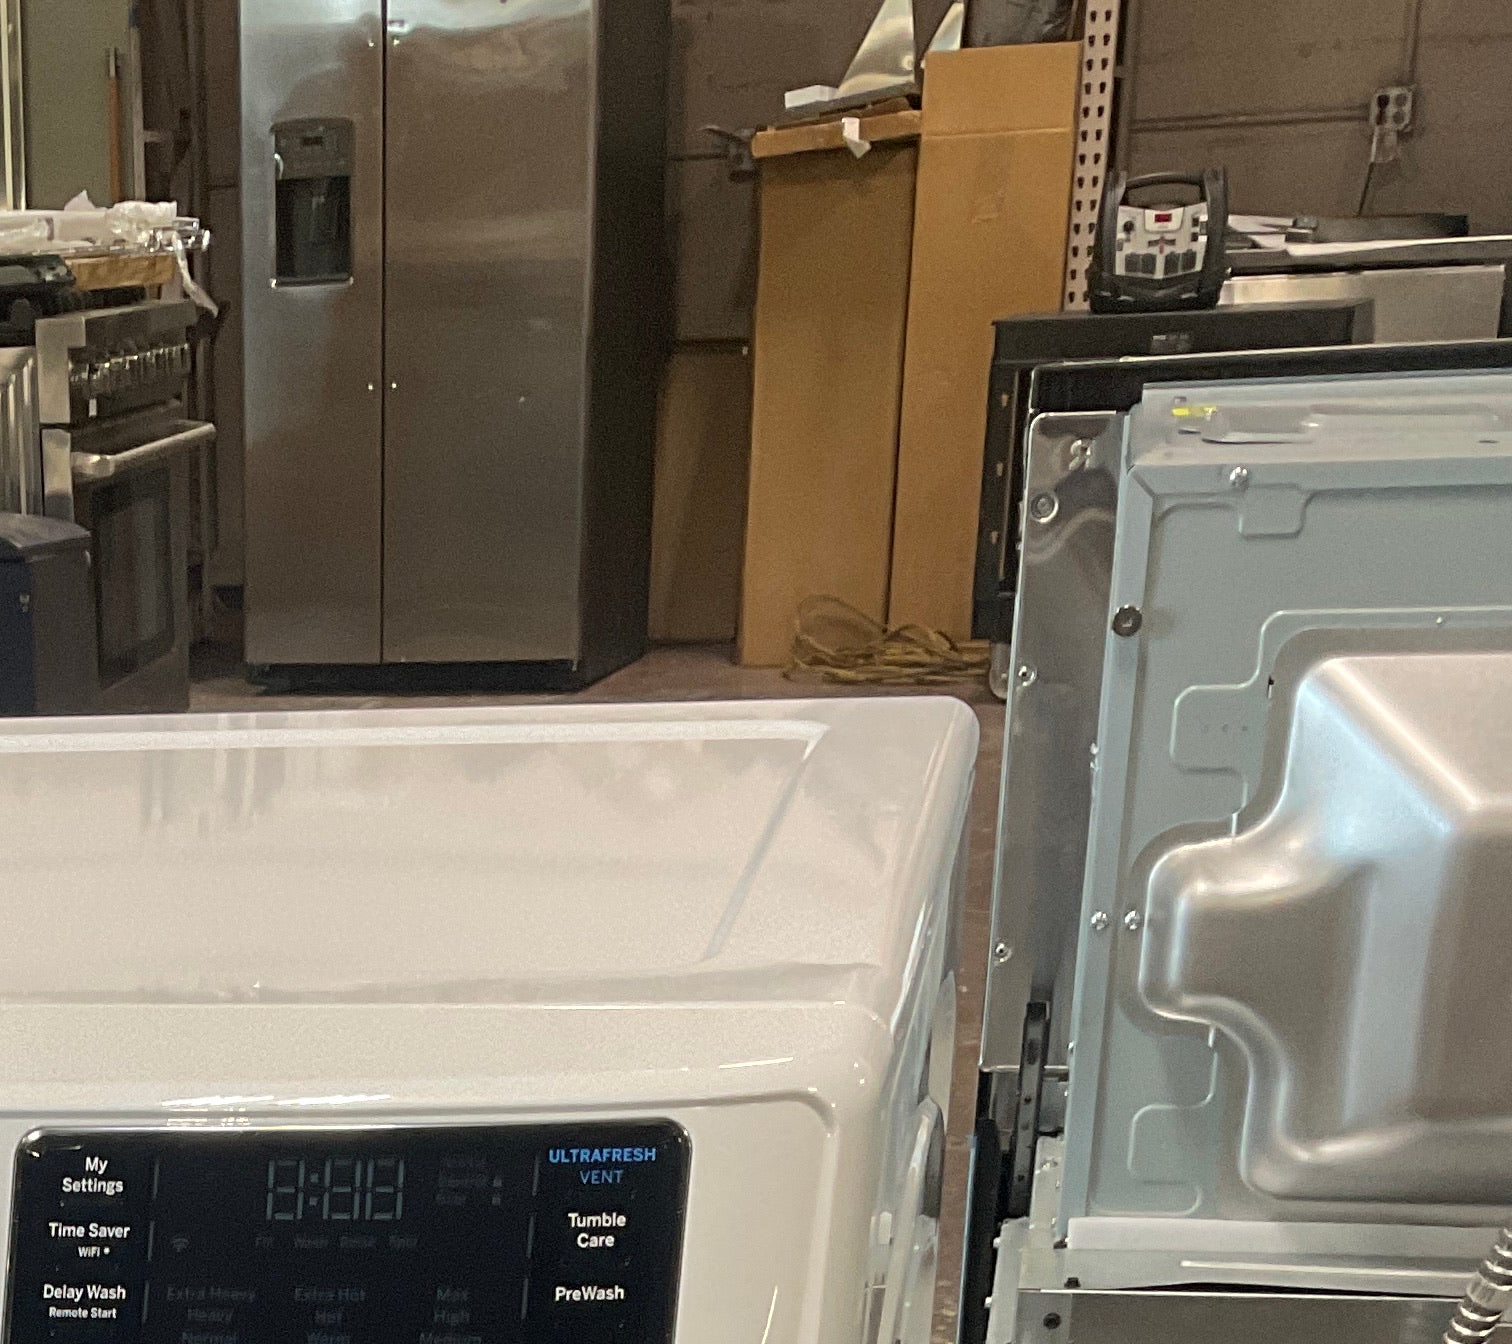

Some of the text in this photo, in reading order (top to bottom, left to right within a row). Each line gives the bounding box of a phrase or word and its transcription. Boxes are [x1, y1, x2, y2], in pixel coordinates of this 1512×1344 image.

[548, 1147, 657, 1163] ULTRAFRESH
[85, 1156, 109, 1175] My
[579, 1169, 625, 1185] VENT
[61, 1176, 124, 1196] Settings
[567, 1212, 627, 1228] Tumble
[48, 1221, 131, 1239] Time Saver
[576, 1232, 615, 1248] Care
[77, 1246, 101, 1258] WiFi
[43, 1283, 127, 1303] Delay Wash
[555, 1285, 625, 1302] PreWash
[48, 1306, 117, 1319] Remote Start
